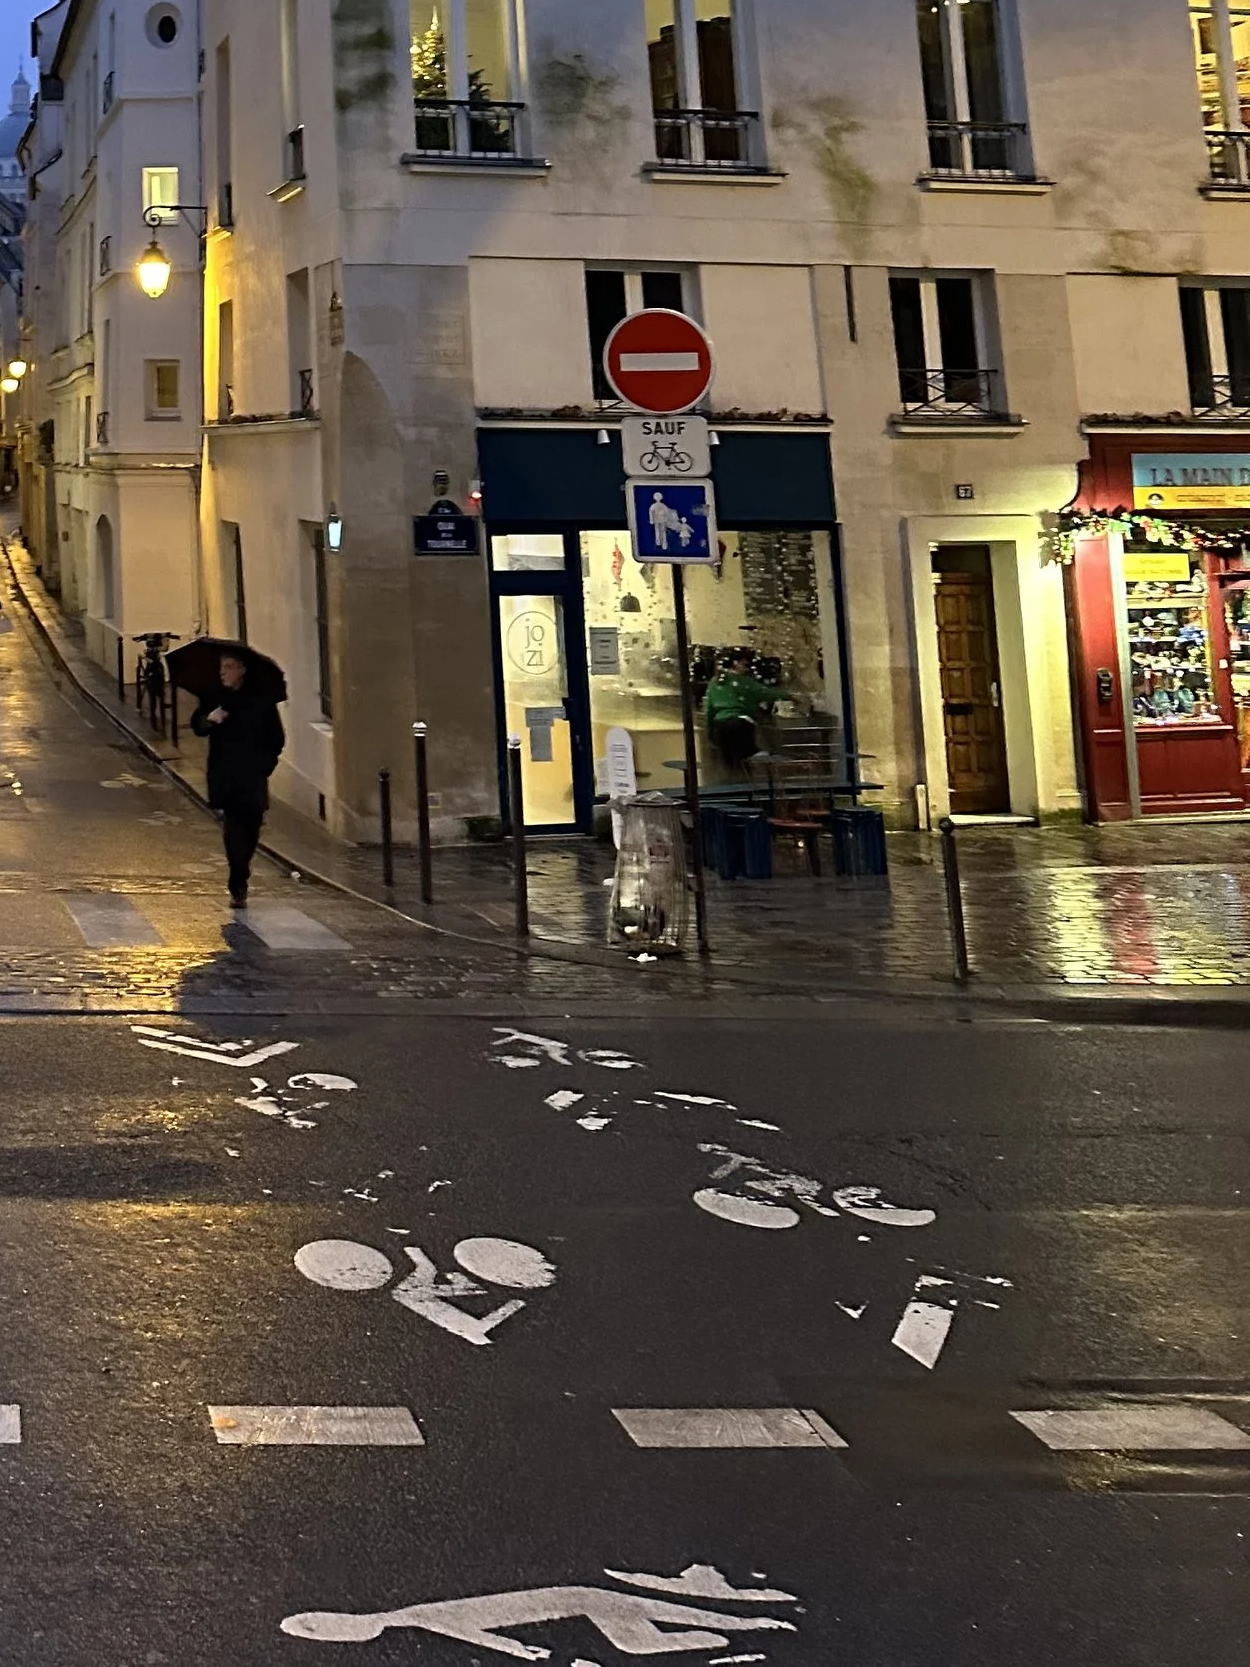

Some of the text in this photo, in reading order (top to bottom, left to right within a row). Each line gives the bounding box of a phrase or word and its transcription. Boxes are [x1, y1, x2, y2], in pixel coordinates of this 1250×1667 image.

[642, 421, 687, 436] SAUF
[1150, 467, 1177, 487] LA
[1180, 467, 1233, 487] MAIN
